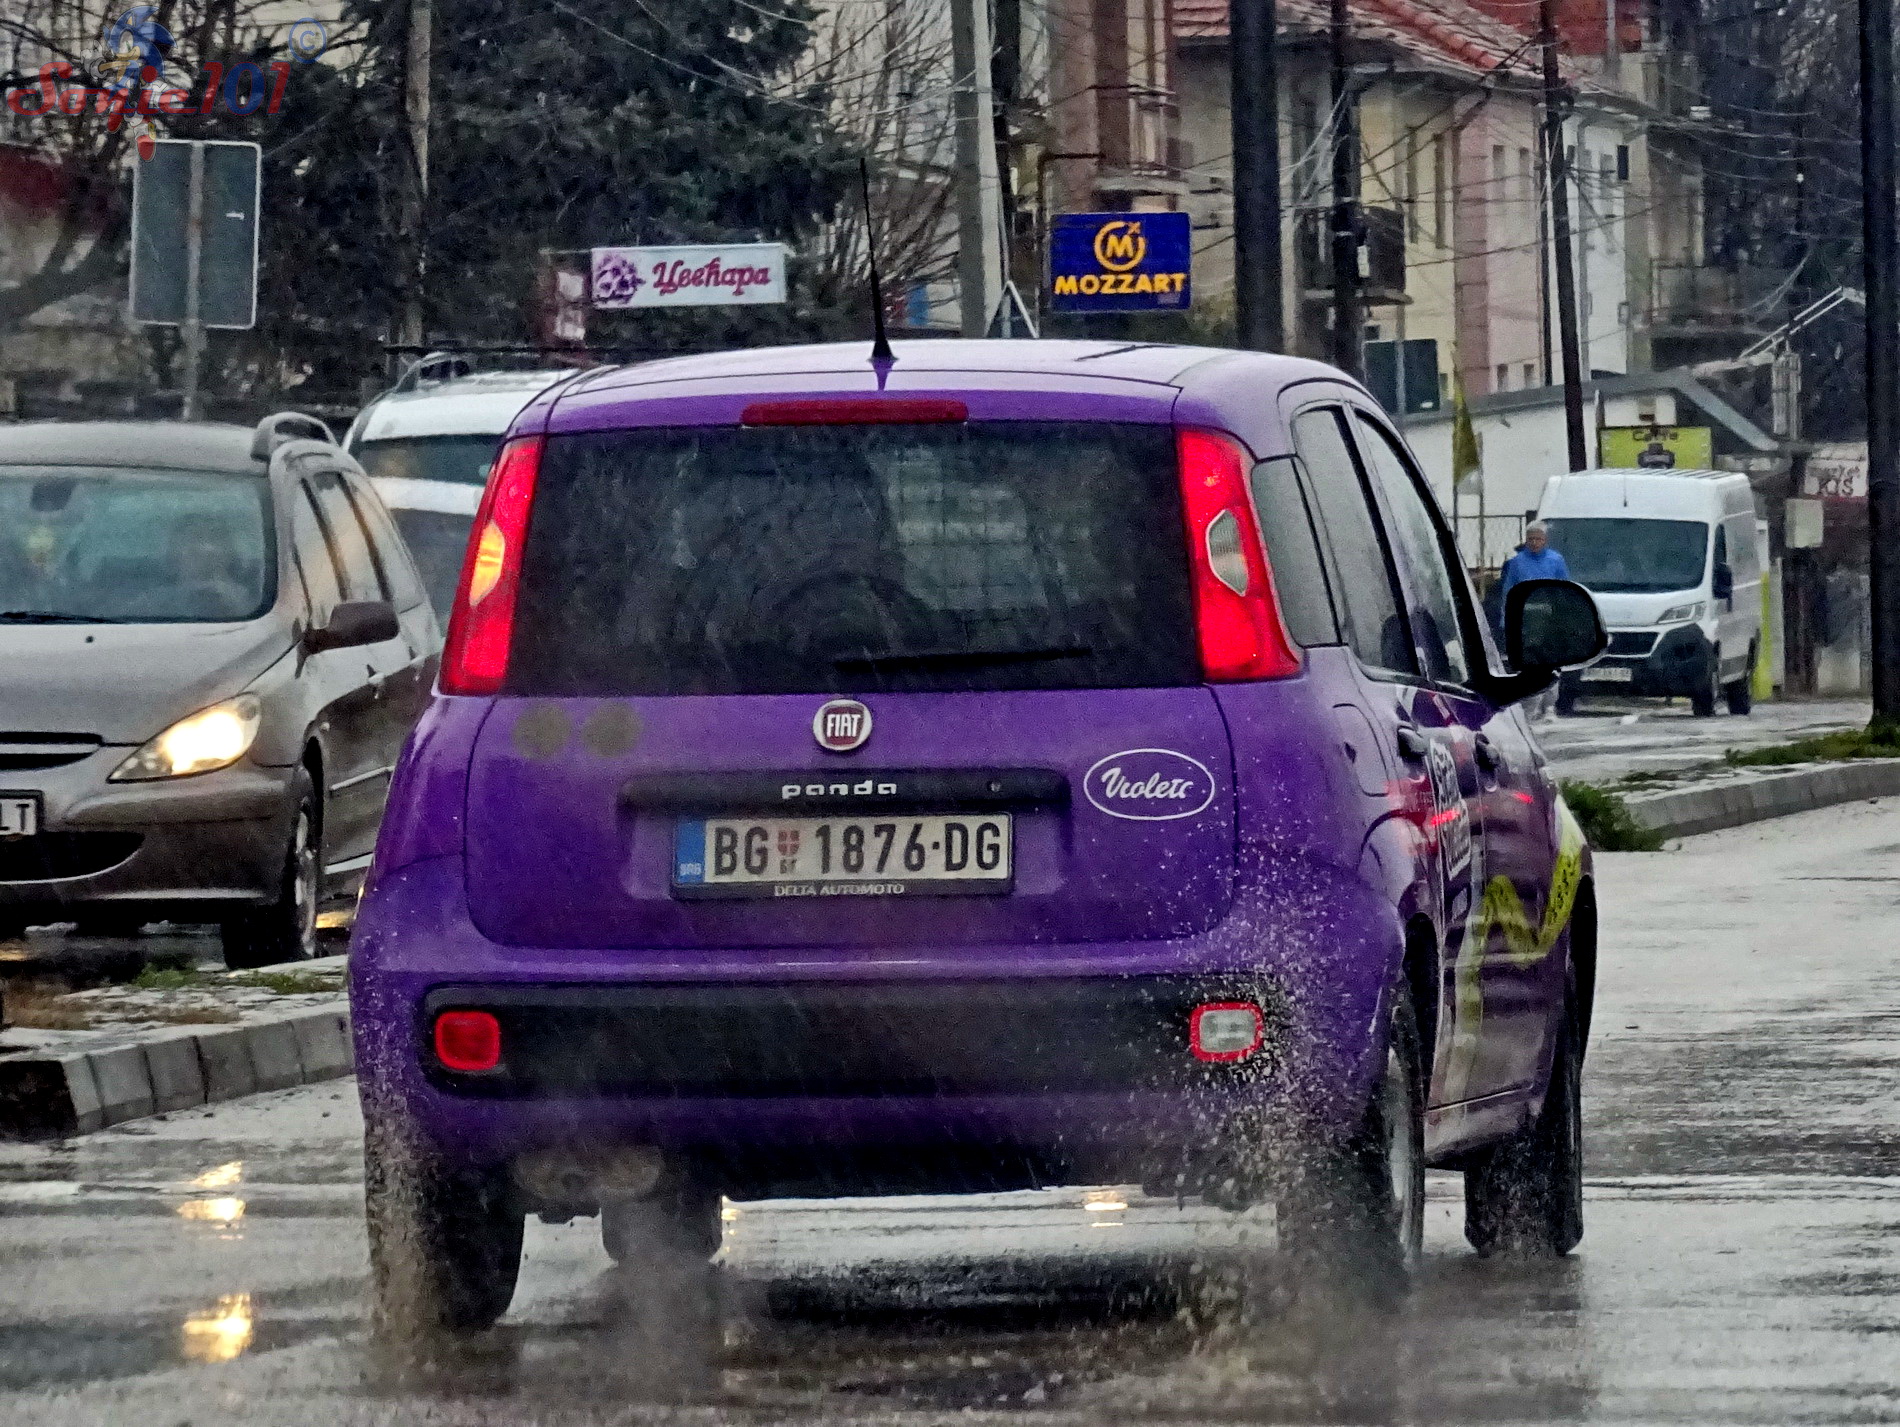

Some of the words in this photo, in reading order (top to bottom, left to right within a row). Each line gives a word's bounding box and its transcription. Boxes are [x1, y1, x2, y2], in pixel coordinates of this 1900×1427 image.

[652, 257, 771, 296] Цвећара
[1054, 273, 1186, 295] MOZZART
[827, 713, 860, 738] FIAT
[781, 780, 897, 799] panda
[714, 826, 769, 876] BG
[774, 884, 816, 897] DELTA
[820, 883, 905, 896] AUTOMOTO
